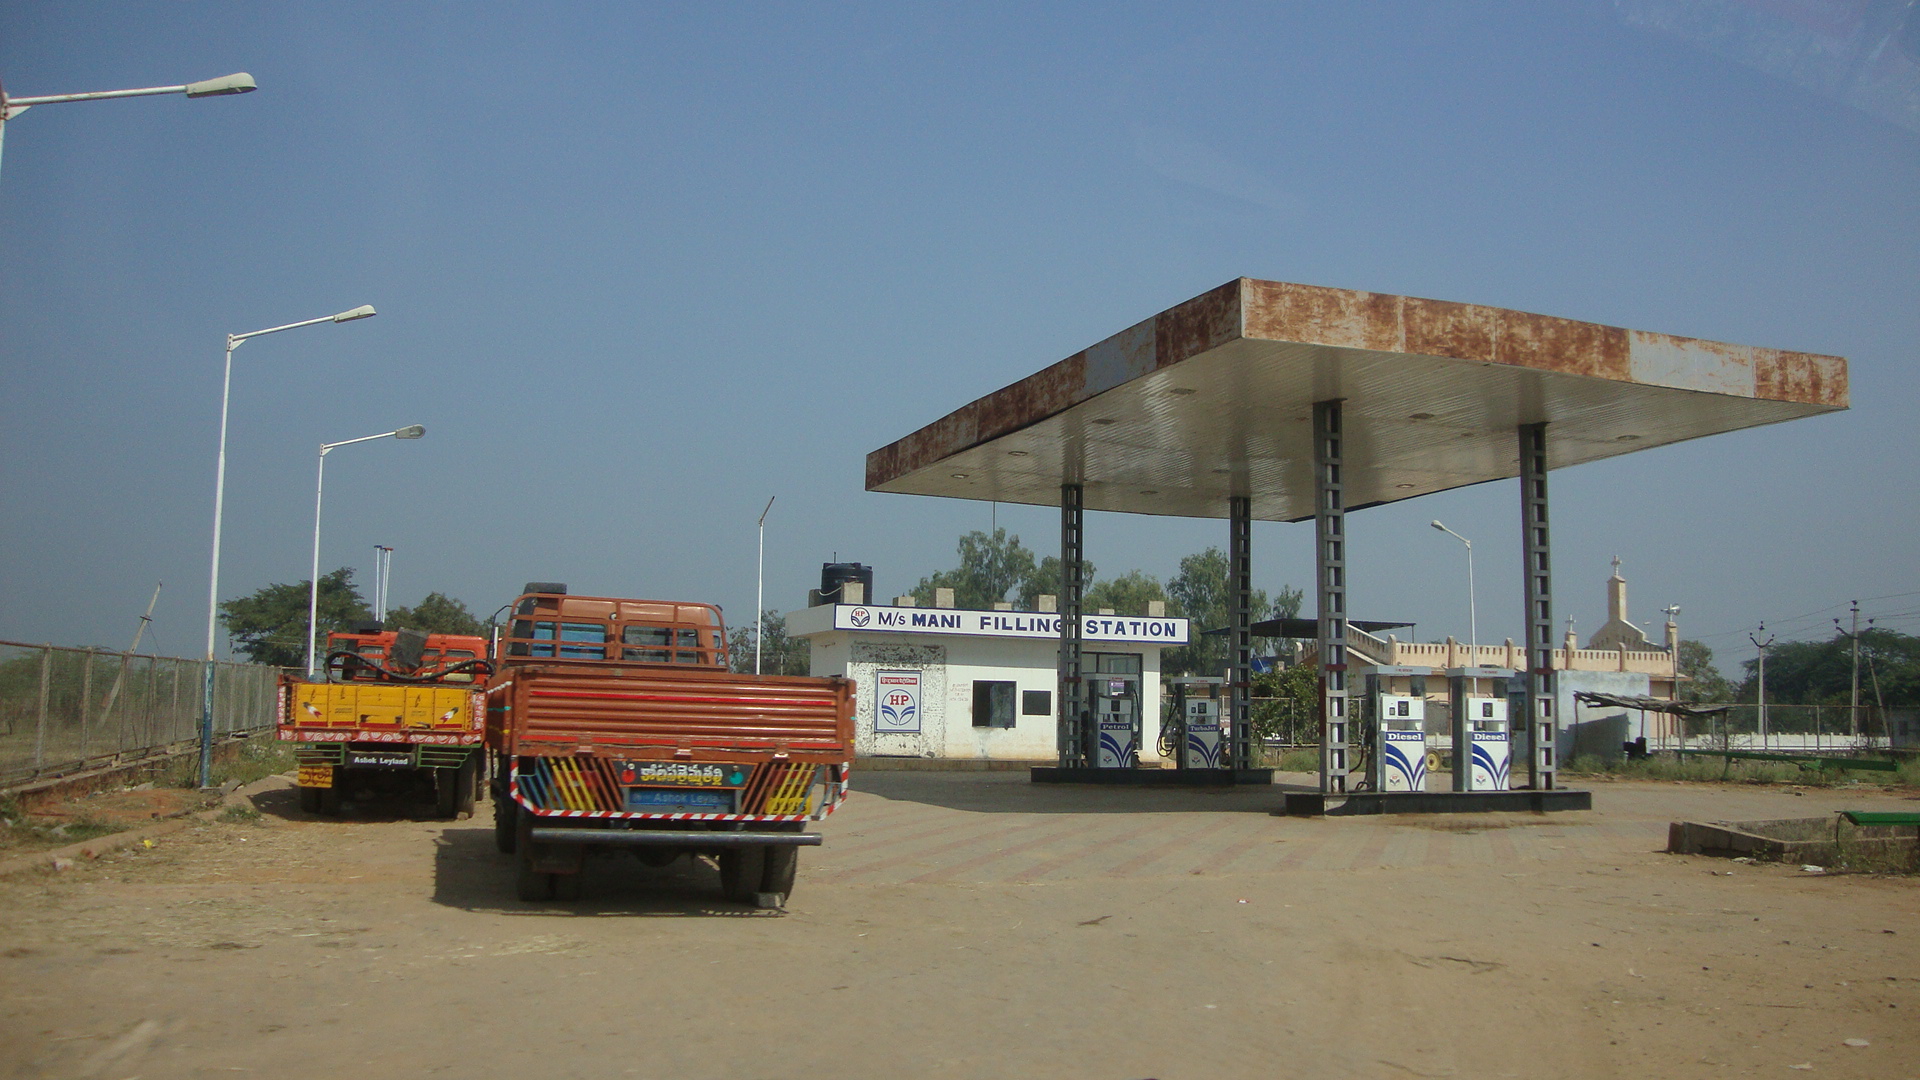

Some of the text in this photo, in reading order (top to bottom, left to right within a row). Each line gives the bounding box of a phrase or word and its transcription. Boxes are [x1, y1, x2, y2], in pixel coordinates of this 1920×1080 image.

[878, 611, 906, 627] M/s
[912, 613, 961, 629] MANI
[1085, 619, 1176, 637] STATION
[889, 694, 909, 706] HP
[1387, 733, 1423, 741] Diesel
[1473, 733, 1506, 742] Diesel
[354, 756, 409, 766] Ashok Leyland
